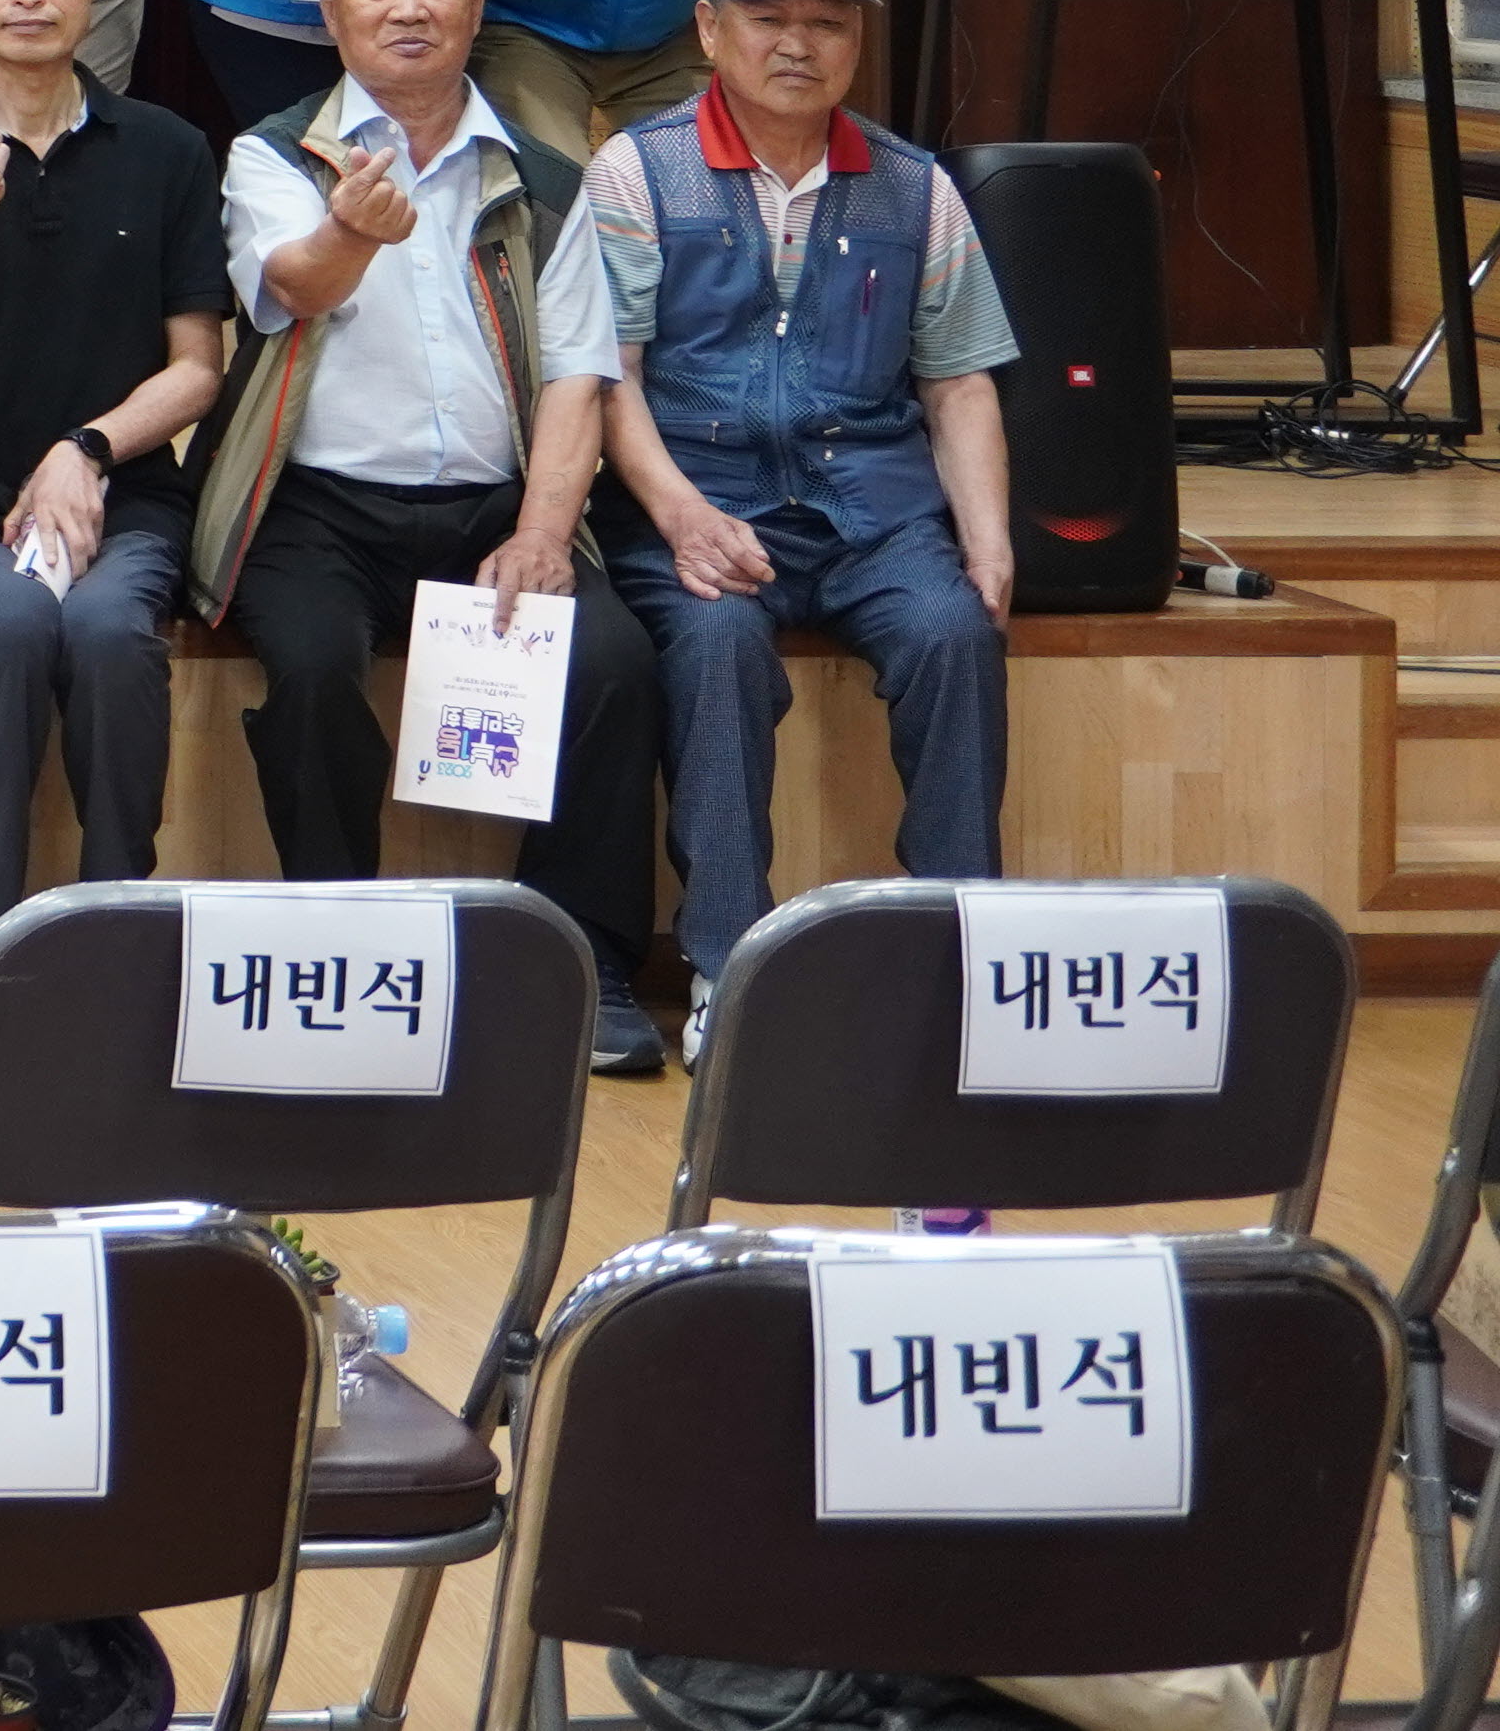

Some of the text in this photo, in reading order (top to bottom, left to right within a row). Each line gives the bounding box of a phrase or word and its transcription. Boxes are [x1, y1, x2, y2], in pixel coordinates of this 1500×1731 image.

[437, 726, 519, 778] 선부1동
[441, 704, 524, 736] 주민총회
[210, 955, 423, 1035] 내빈석
[990, 952, 1199, 1030] 내빈석
[853, 1332, 1144, 1437] 내빈석
